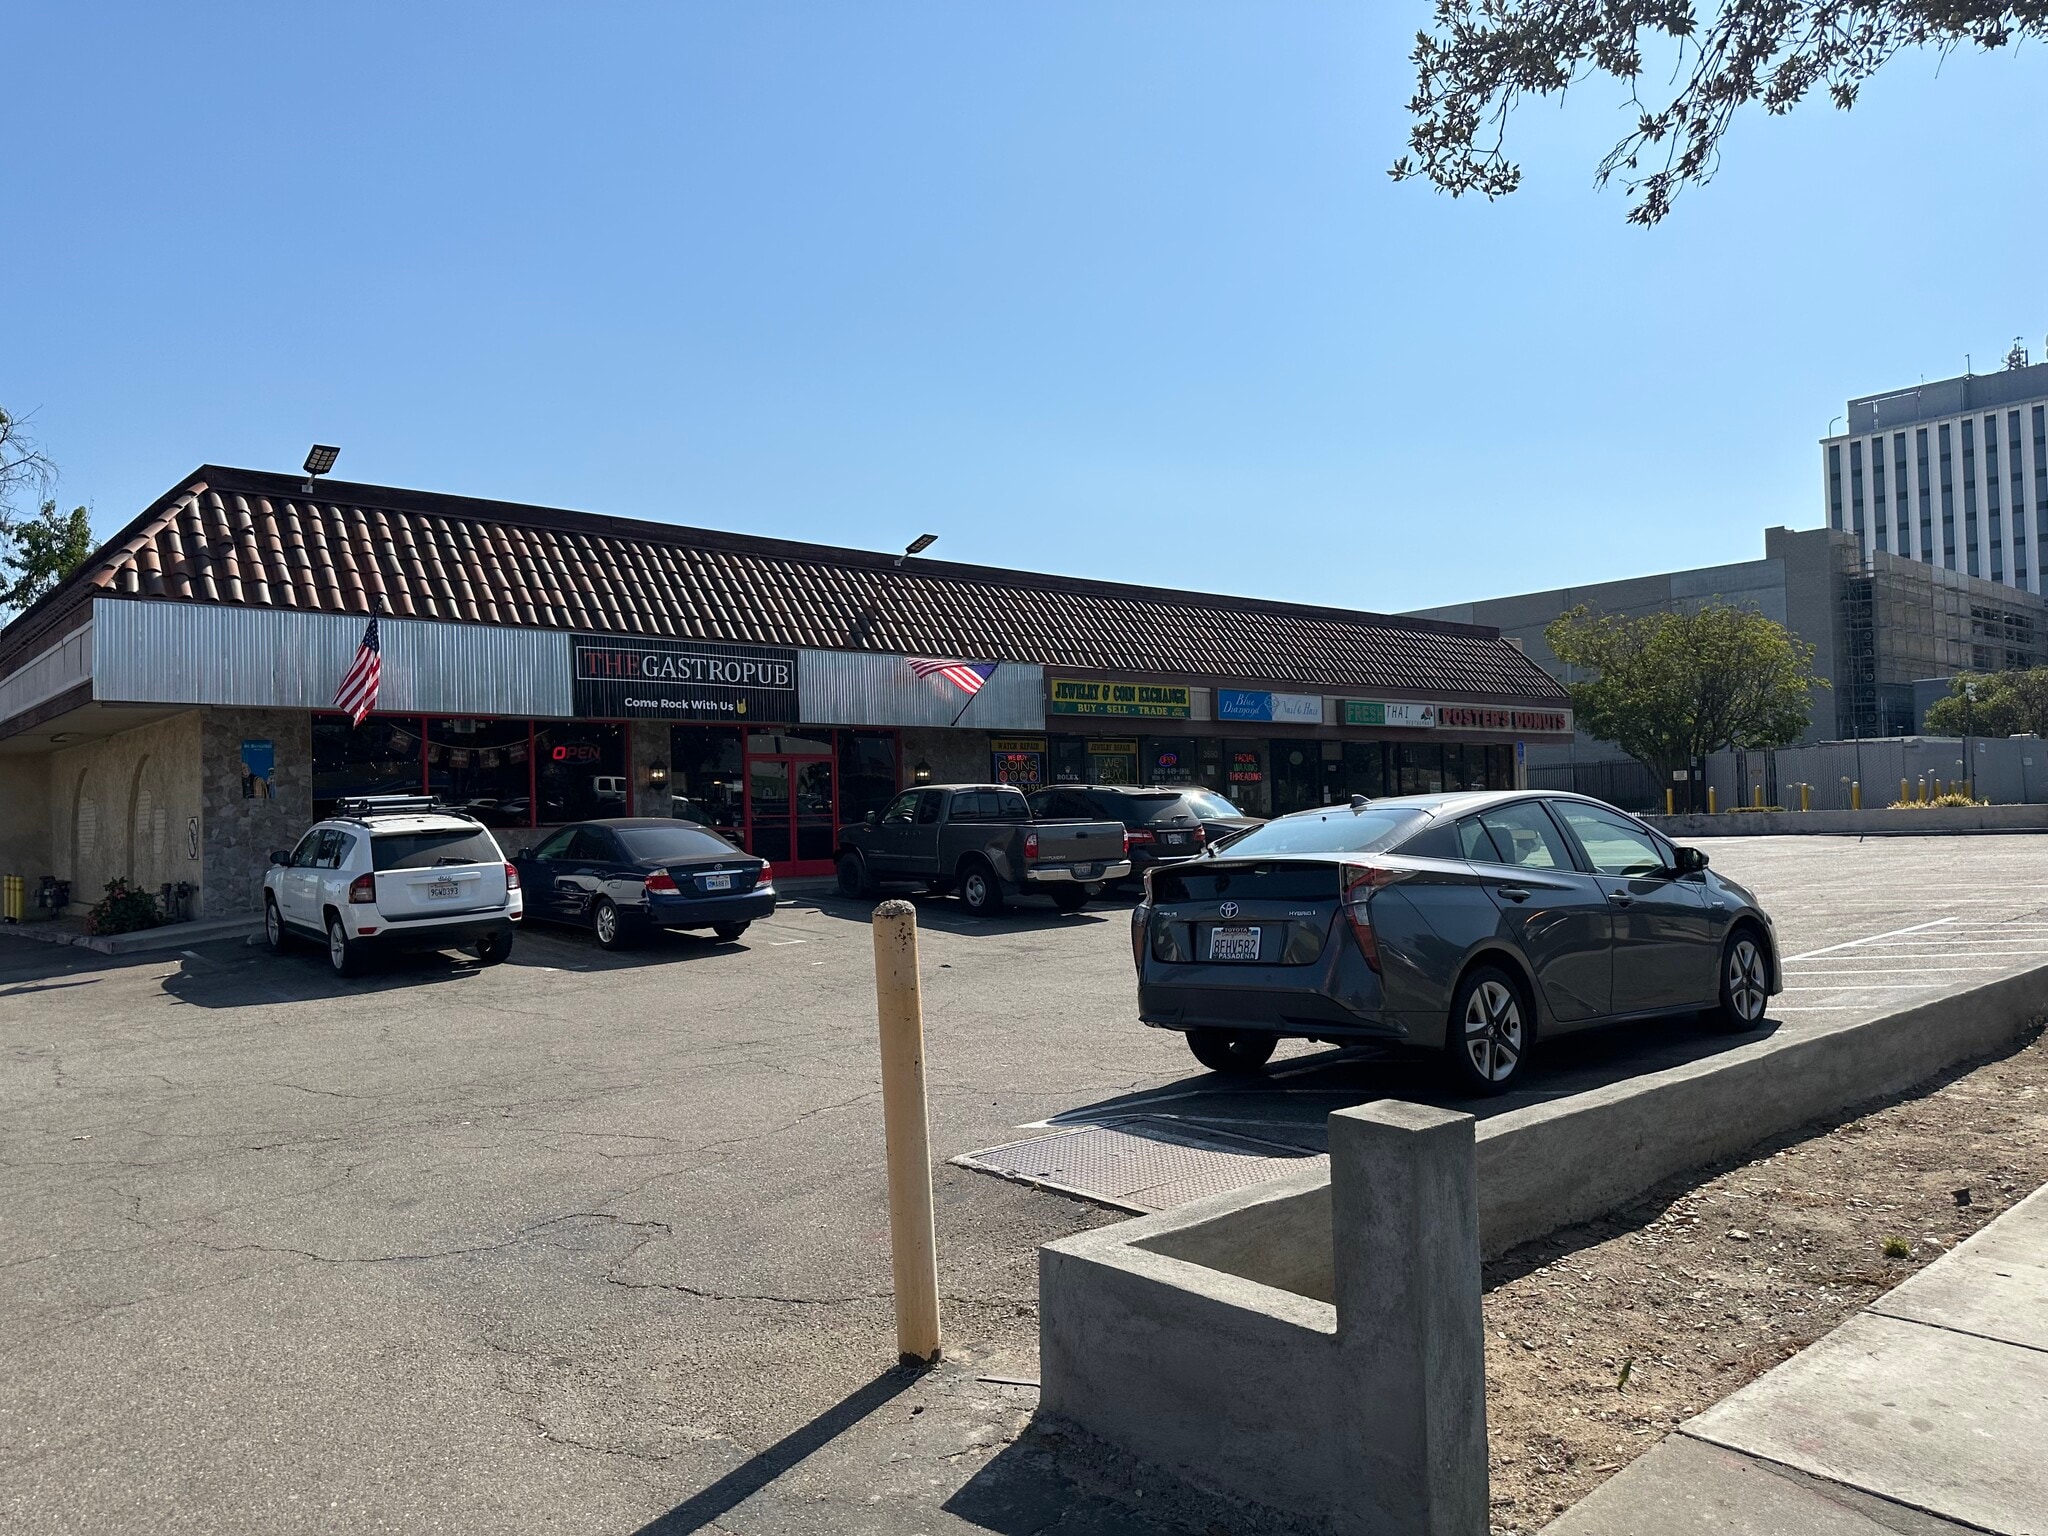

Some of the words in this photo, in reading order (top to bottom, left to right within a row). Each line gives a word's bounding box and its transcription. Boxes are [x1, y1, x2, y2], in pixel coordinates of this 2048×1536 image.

[585, 652, 640, 676] THE
[642, 655, 789, 685] GASTROPUB
[1055, 682, 1100, 700] JEWELRY
[1113, 685, 1136, 702] COIN
[1138, 686, 1187, 704] EXCHANGE
[1235, 693, 1255, 706] Blue
[624, 698, 659, 708] Come
[660, 698, 689, 709] Rock
[691, 700, 717, 710] With
[720, 702, 734, 711] Us
[1077, 703, 1096, 713] BUY
[1106, 705, 1128, 714] SELL
[1138, 706, 1168, 716] TRADE
[1223, 701, 1262, 717] Diamond
[1347, 704, 1384, 722] FRESH
[1386, 705, 1409, 719] THAI
[1512, 711, 1566, 729] DONUTS
[552, 746, 601, 760] OPEN
[1019, 742, 1039, 751] REPAIR
[998, 760, 1038, 771] COINS
[1233, 763, 1258, 772] WAXING
[1229, 772, 1262, 781] THREADING
